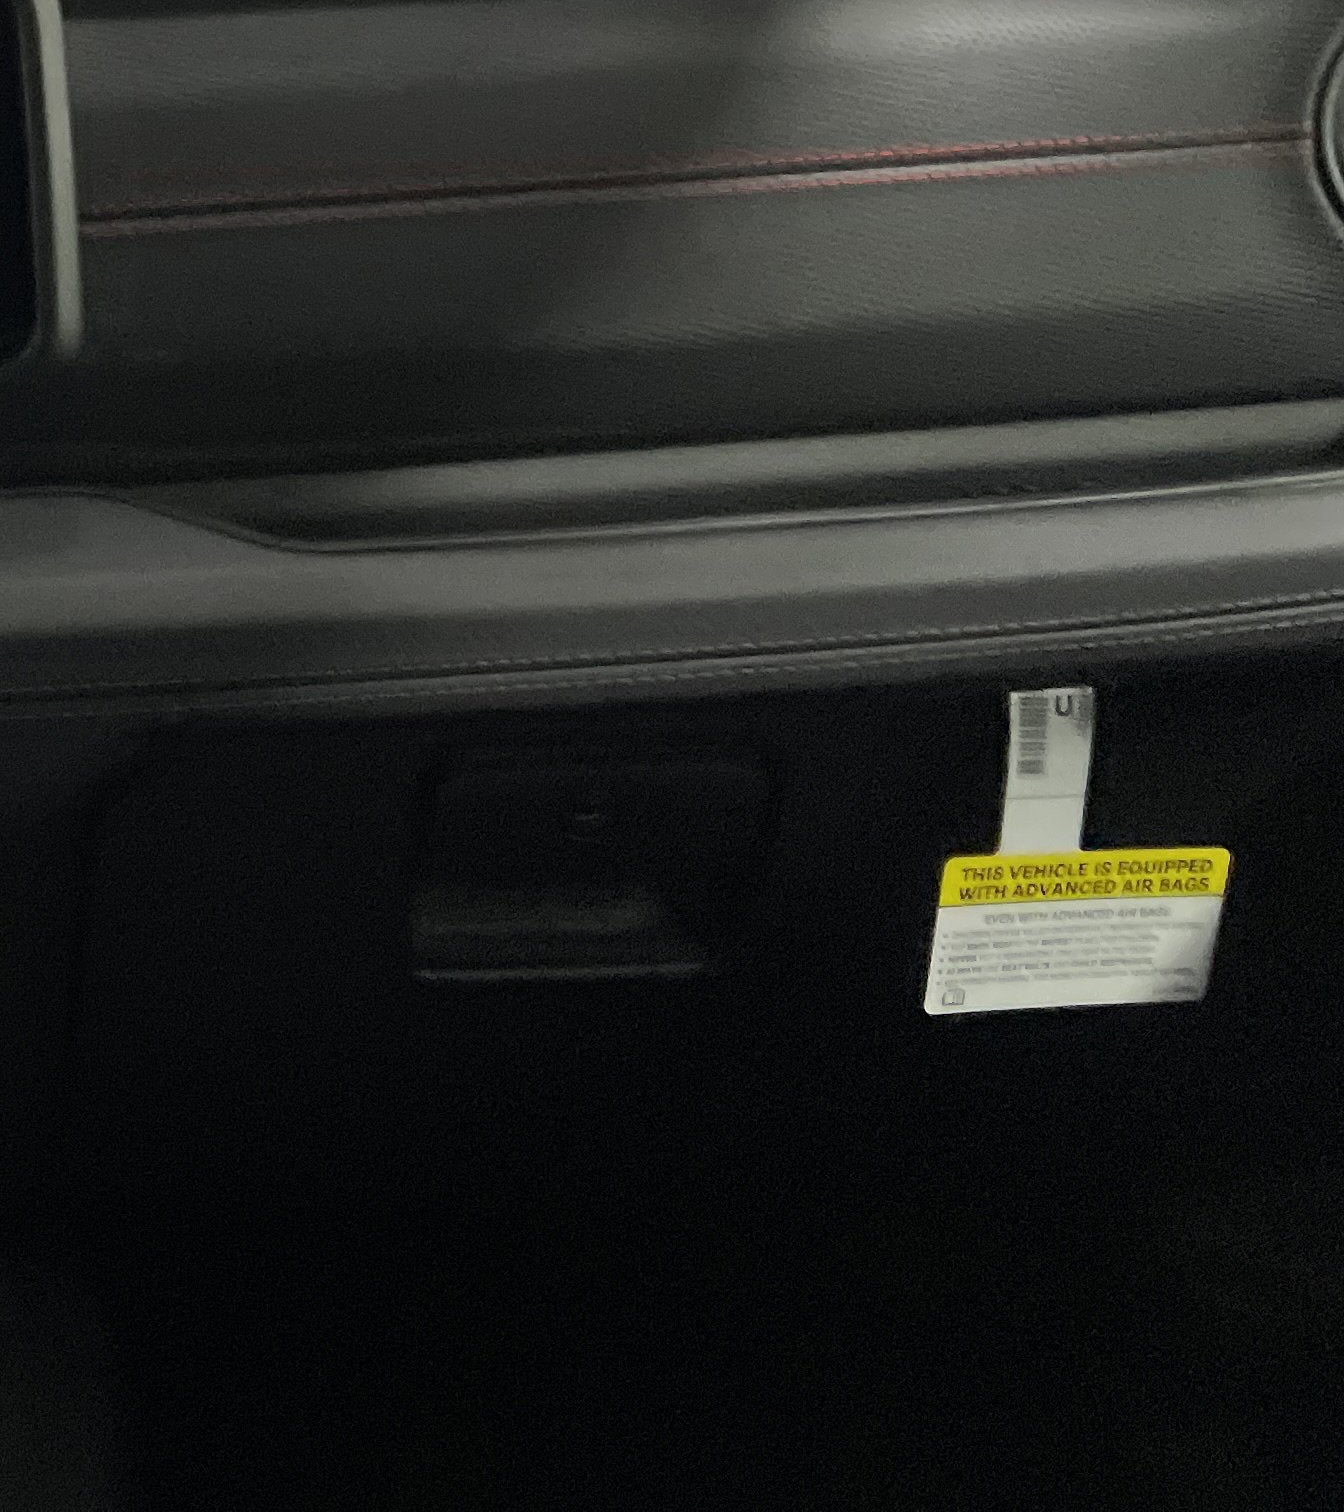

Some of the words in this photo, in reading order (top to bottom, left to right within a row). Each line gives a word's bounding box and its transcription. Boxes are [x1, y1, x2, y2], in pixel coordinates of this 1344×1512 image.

[1054, 695, 1073, 717] U
[962, 866, 1005, 883] THIS
[1008, 862, 1088, 881] VEHICLE
[1094, 861, 1113, 878] IS
[1117, 858, 1214, 877] EQUIPPED
[959, 884, 1008, 901] WITH
[1012, 879, 1117, 899] ADVANCED
[1122, 878, 1154, 893] AIR
[1159, 876, 1211, 893] BAGS
